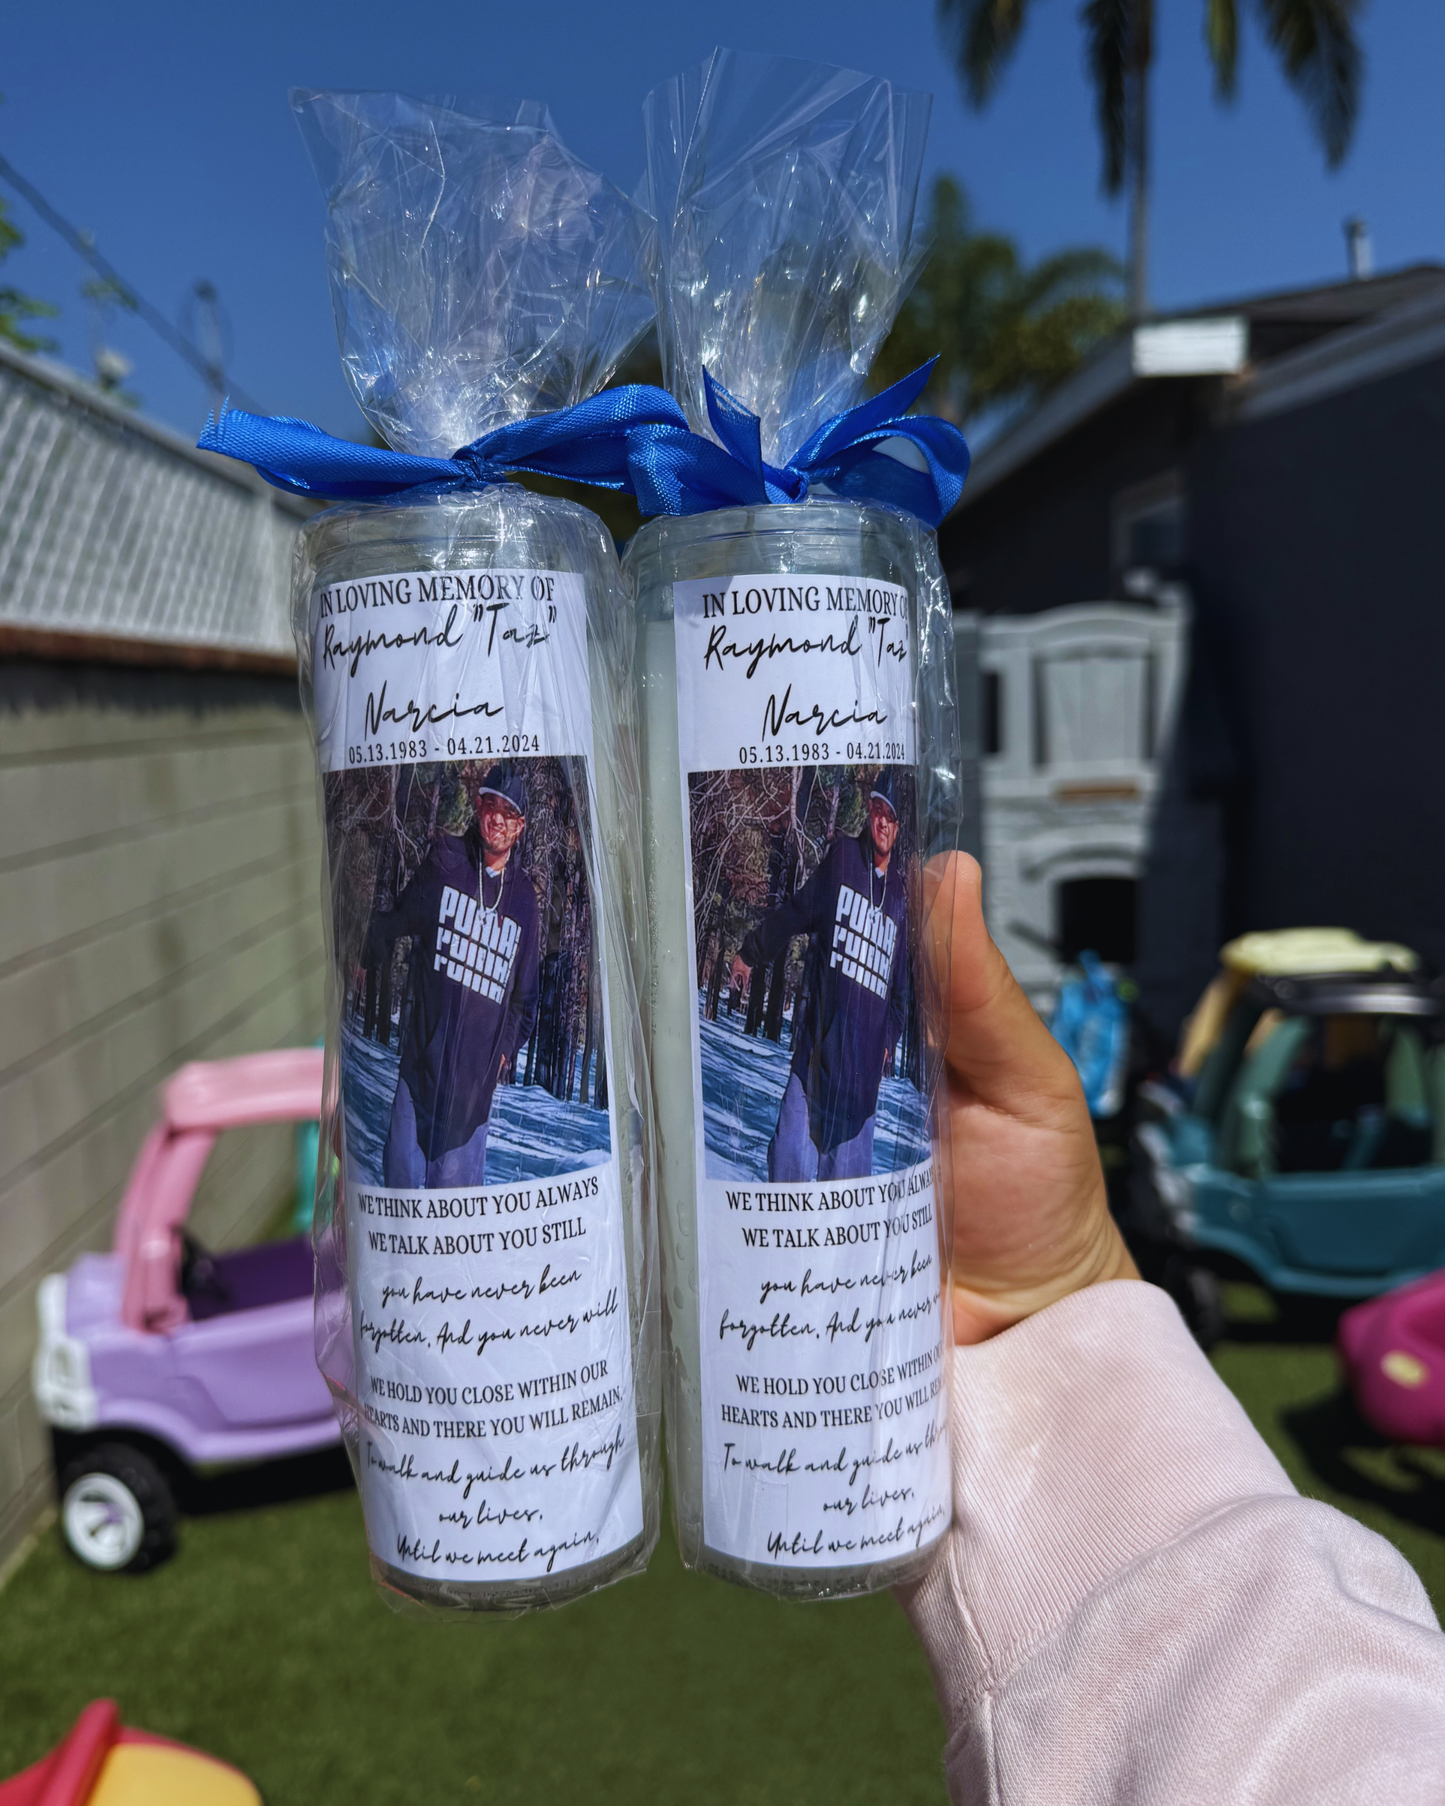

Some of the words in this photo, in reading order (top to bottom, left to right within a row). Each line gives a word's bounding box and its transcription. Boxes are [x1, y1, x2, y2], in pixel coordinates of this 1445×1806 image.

[320, 591, 333, 618] IN
[336, 578, 412, 614] LOVING
[417, 574, 524, 602] MEMORY
[530, 576, 555, 601] OF
[702, 592, 726, 619] IN
[732, 586, 820, 615] LOVING
[826, 587, 897, 616] MEMORY
[323, 604, 463, 677] Raymond
[704, 614, 862, 679] Raymond
[349, 740, 428, 764] 05.13.1983
[447, 735, 540, 755] 04.21.2024
[739, 743, 830, 764] 05.13.1983
[847, 742, 905, 760] 04.21.2024
[358, 1193, 374, 1214] WE
[375, 1198, 423, 1219] THINK
[426, 1194, 488, 1219] ABOUT
[492, 1190, 531, 1214] YOU
[536, 1176, 599, 1209] ALWAYS
[726, 1191, 752, 1211] WE
[755, 1192, 815, 1212] THINK
[817, 1186, 876, 1212] ABOUT
[878, 1179, 906, 1203] YOU
[908, 1164, 934, 1196] ALWAY
[368, 1231, 387, 1251] WE
[389, 1234, 429, 1255] TALK
[432, 1233, 494, 1255] ABOUT
[498, 1227, 537, 1250] YOU
[542, 1217, 586, 1244] STILL
[741, 1227, 769, 1247] WE
[772, 1229, 820, 1248] TALK
[823, 1222, 881, 1248] ABOUT
[883, 1213, 909, 1239] YOU
[911, 1203, 932, 1231] STILL
[382, 1282, 410, 1309] you
[412, 1276, 467, 1304] have
[471, 1282, 535, 1300] never
[538, 1264, 582, 1295] been
[761, 1280, 797, 1304] you
[801, 1268, 856, 1297] have
[860, 1265, 908, 1287] never
[910, 1249, 933, 1279] been
[436, 1319, 474, 1354] And
[477, 1325, 516, 1356] you
[519, 1315, 580, 1338] never
[582, 1287, 619, 1323] will
[825, 1307, 863, 1343] And
[865, 1312, 896, 1343] you
[899, 1296, 932, 1315] never
[370, 1376, 385, 1396] WE
[387, 1382, 422, 1403] HOLD
[425, 1387, 458, 1405] YOU
[462, 1383, 514, 1405] CLOSE
[517, 1369, 577, 1399] WITHIN
[580, 1359, 608, 1384] OUR
[736, 1374, 760, 1393] WE
[764, 1377, 809, 1396] HOLD
[812, 1376, 847, 1395] YOU
[850, 1366, 895, 1392] CLOSE
[897, 1350, 932, 1381] WITHIN
[933, 1340, 943, 1362] OU
[364, 1403, 400, 1433] HEARTS
[402, 1418, 430, 1437] AND
[433, 1420, 487, 1438] THERE
[490, 1416, 525, 1436] YOU
[529, 1407, 568, 1431] WILL
[721, 1404, 778, 1428] HEARTS
[782, 1411, 817, 1428] AND
[820, 1405, 872, 1428] THERE
[875, 1397, 903, 1420] YOU
[905, 1386, 929, 1411] WILL
[421, 1459, 462, 1484] and
[463, 1456, 526, 1499] guide
[530, 1462, 557, 1477] us
[561, 1423, 625, 1473] through
[723, 1442, 742, 1474] To
[745, 1448, 800, 1476] walk
[804, 1447, 849, 1473] and
[849, 1438, 902, 1486] guide
[905, 1441, 923, 1455] us
[439, 1511, 473, 1529] our
[822, 1498, 857, 1516] our
[397, 1533, 442, 1565] Until
[445, 1552, 474, 1565] we
[477, 1539, 529, 1566] meet
[767, 1530, 823, 1560] Until
[827, 1540, 857, 1553] we
[860, 1516, 905, 1550] meet
